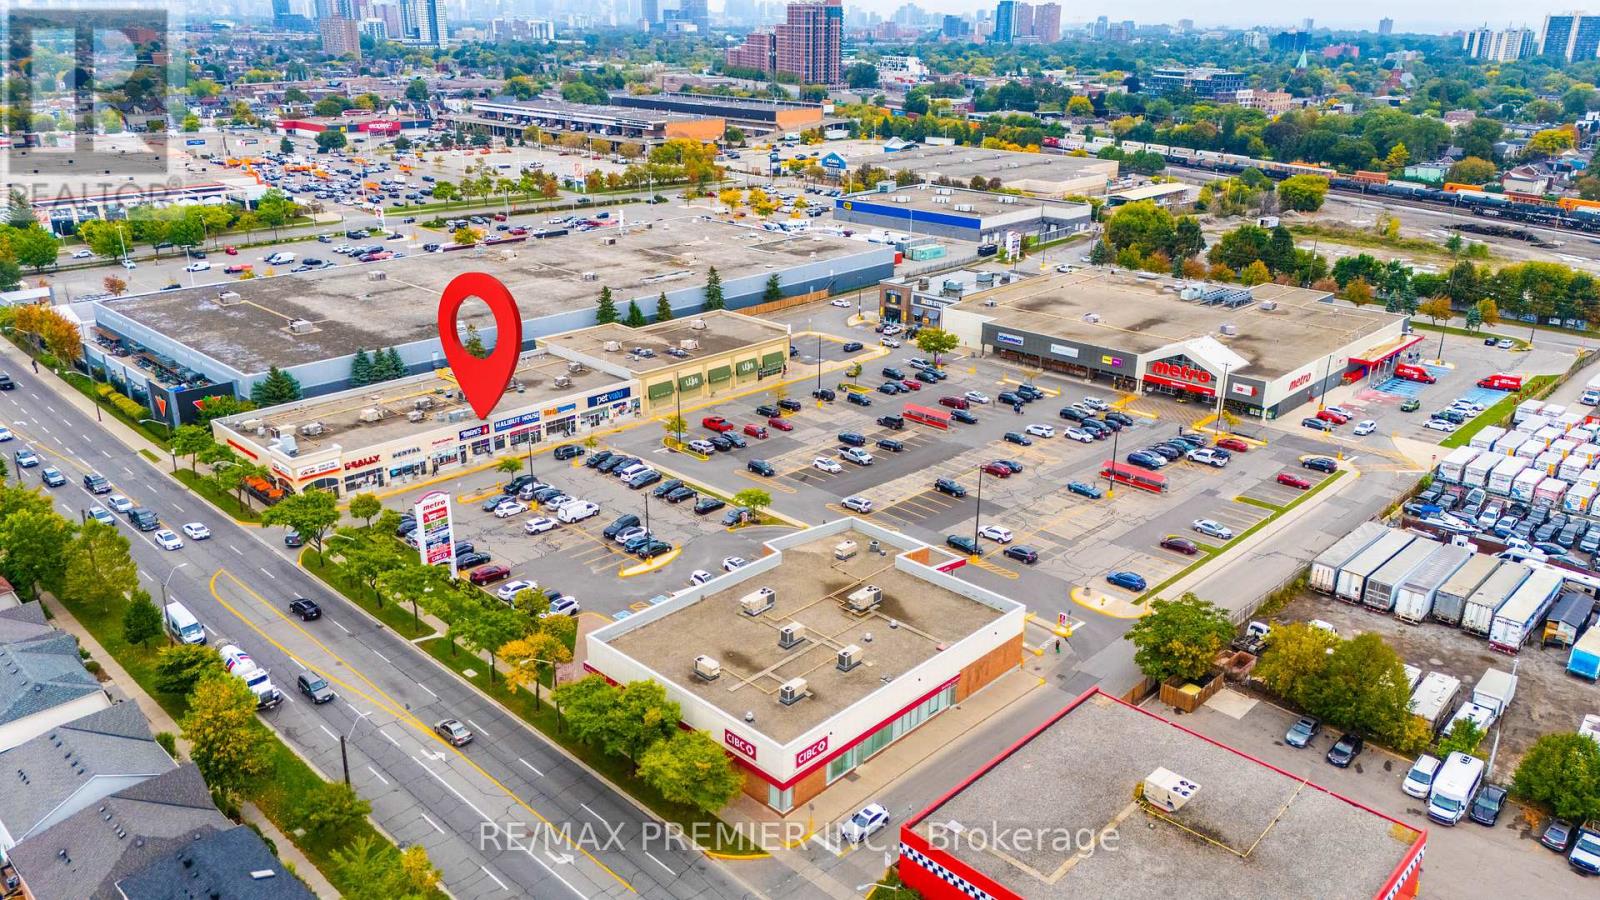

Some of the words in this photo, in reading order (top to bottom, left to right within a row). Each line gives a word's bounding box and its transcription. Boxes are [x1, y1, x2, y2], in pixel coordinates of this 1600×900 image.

[1151, 361, 1212, 383] metro
[1288, 372, 1312, 391] metro
[495, 417, 520, 428] HALIBUT
[522, 412, 540, 422] HOUSE
[423, 499, 446, 511] metro
[726, 732, 747, 751] CIBC
[797, 744, 818, 764] CIBC
